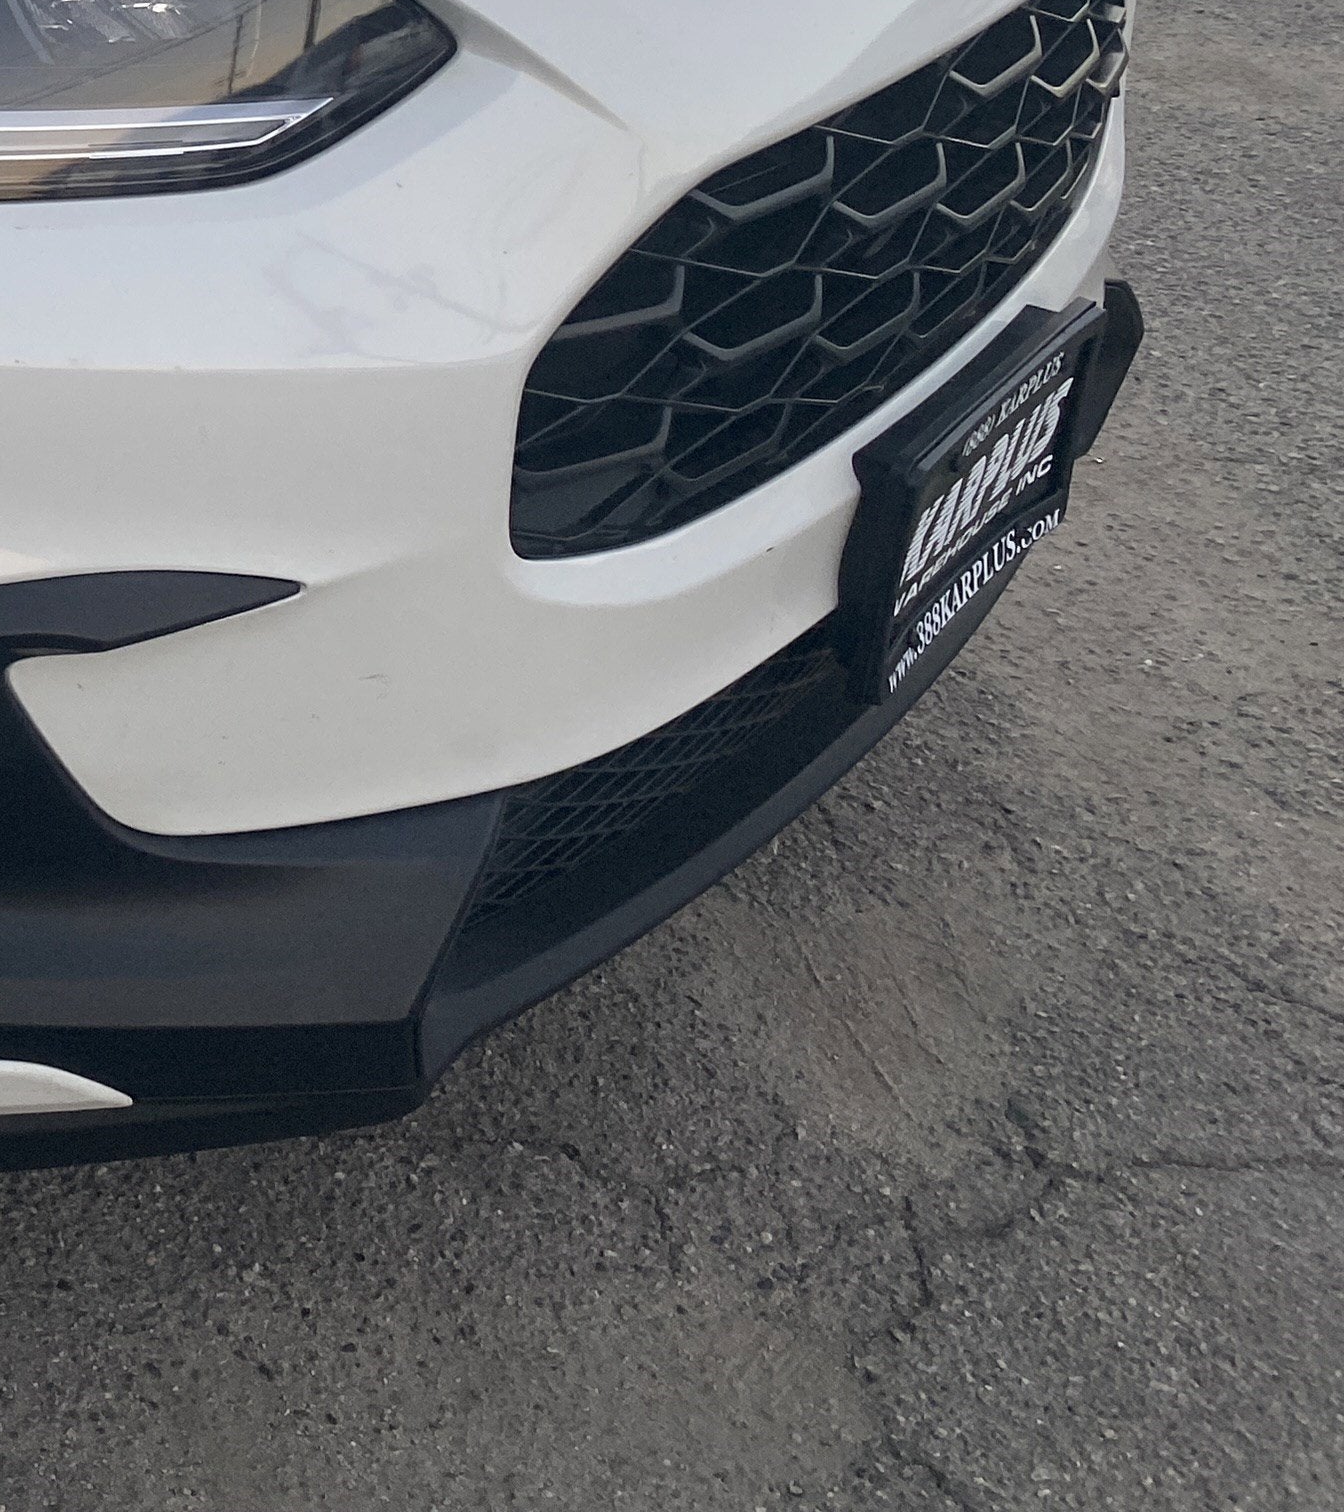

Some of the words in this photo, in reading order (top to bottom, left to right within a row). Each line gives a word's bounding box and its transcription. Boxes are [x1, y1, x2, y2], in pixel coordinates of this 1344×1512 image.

[994, 351, 1065, 428] KARPLUS
[898, 376, 1075, 588] KARPLUS
[1015, 454, 1054, 497] INC
